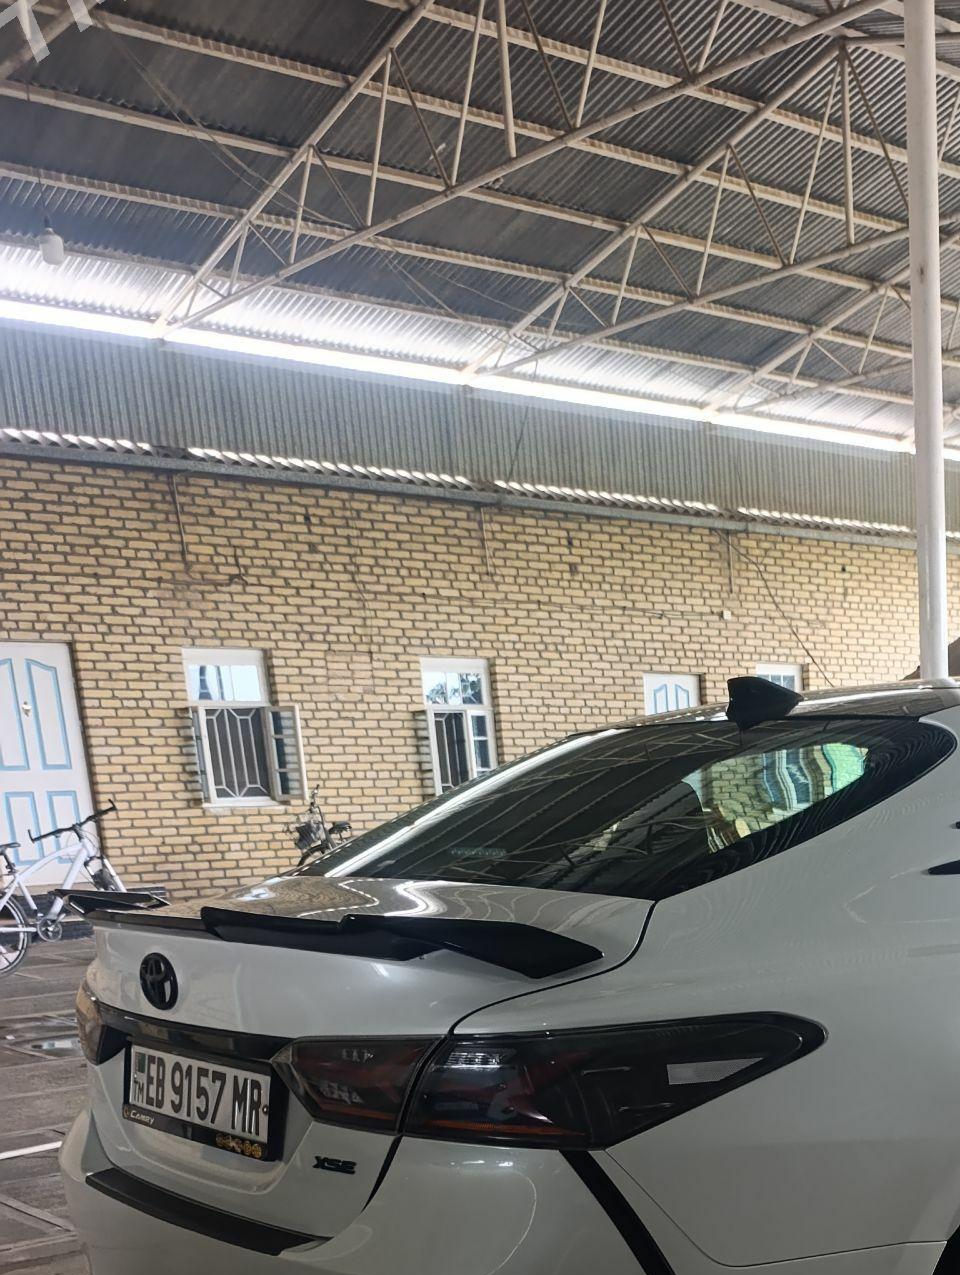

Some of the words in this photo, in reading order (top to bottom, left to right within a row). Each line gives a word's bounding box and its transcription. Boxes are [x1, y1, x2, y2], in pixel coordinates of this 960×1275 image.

[133, 1079, 145, 1104] TM
[145, 1054, 166, 1109] EB
[170, 1061, 227, 1125] 9157
[231, 1075, 262, 1136] MR
[312, 1155, 358, 1175] XSE
